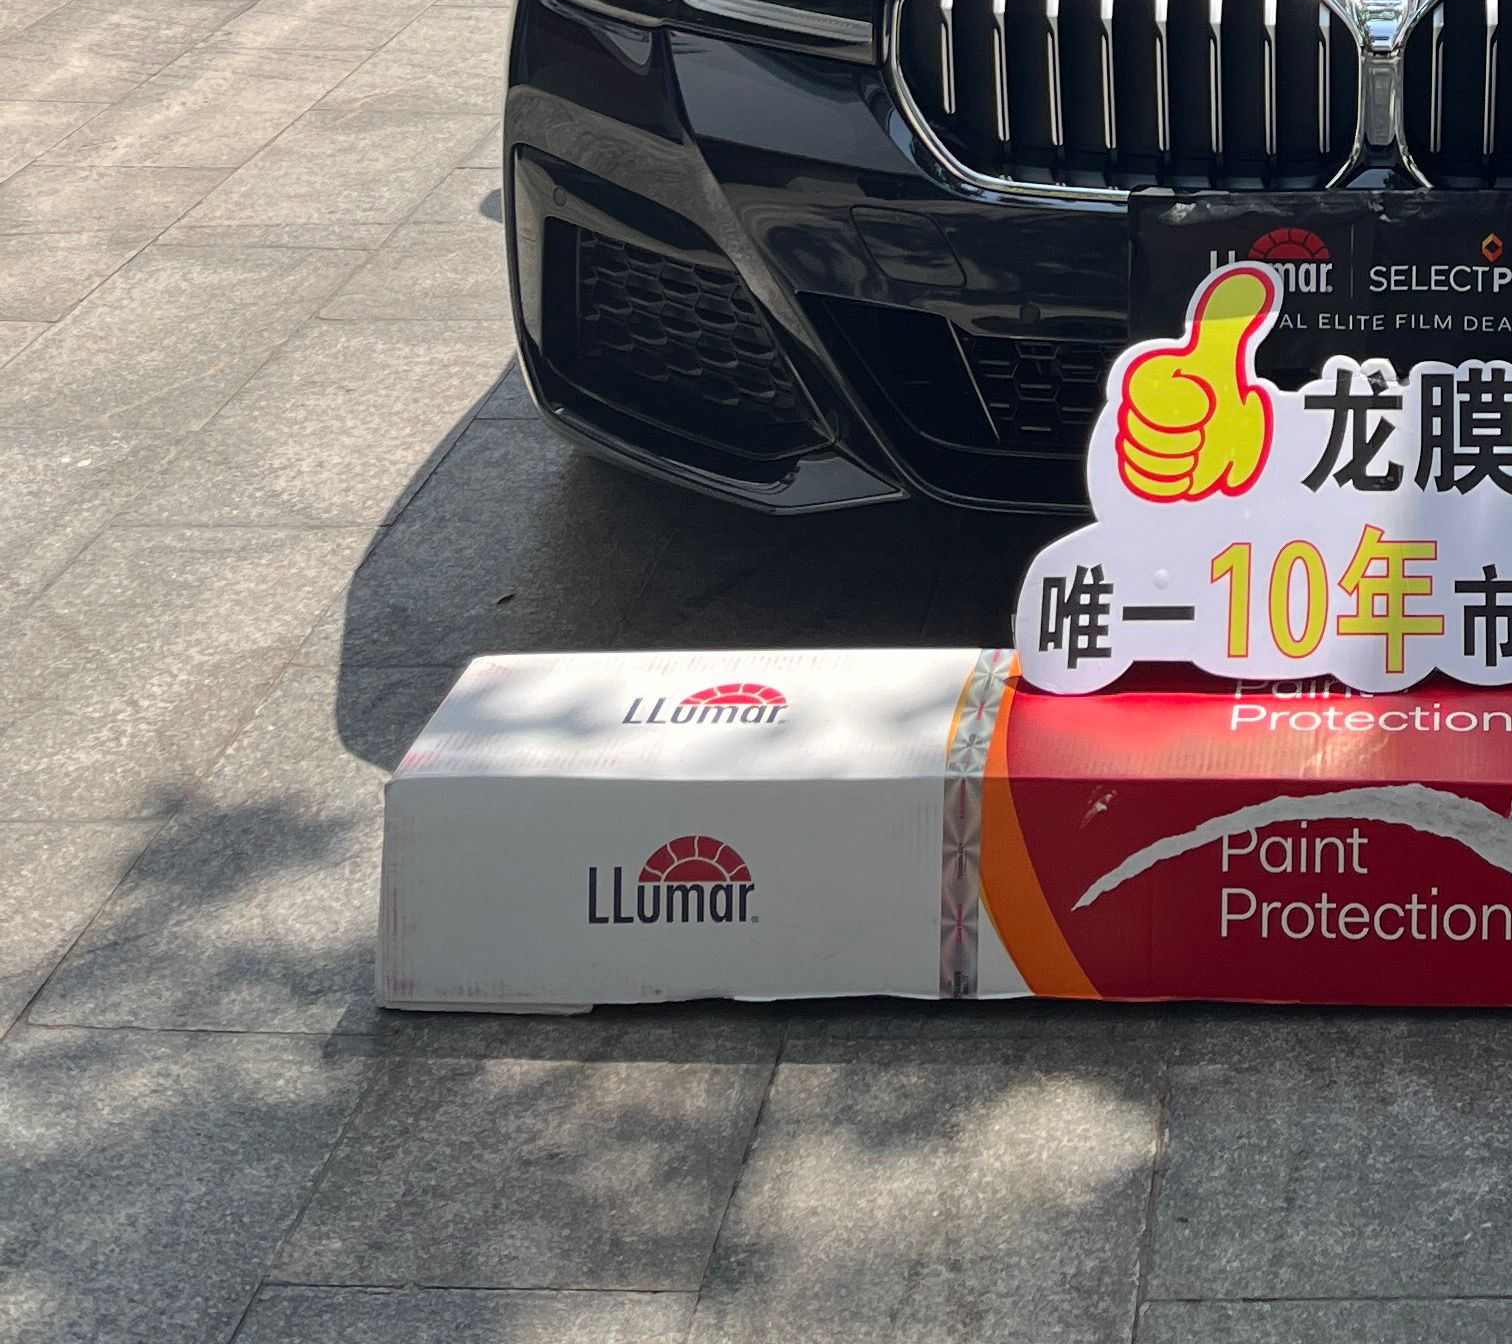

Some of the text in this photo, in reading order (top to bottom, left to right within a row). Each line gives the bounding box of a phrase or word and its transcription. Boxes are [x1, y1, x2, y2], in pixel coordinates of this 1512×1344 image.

[1318, 313, 1385, 331] ELITE
[1395, 313, 1453, 331] FILM
[1229, 703, 1512, 733] Protection
[1221, 821, 1368, 874] Paint
[1220, 887, 1512, 941] Protection
